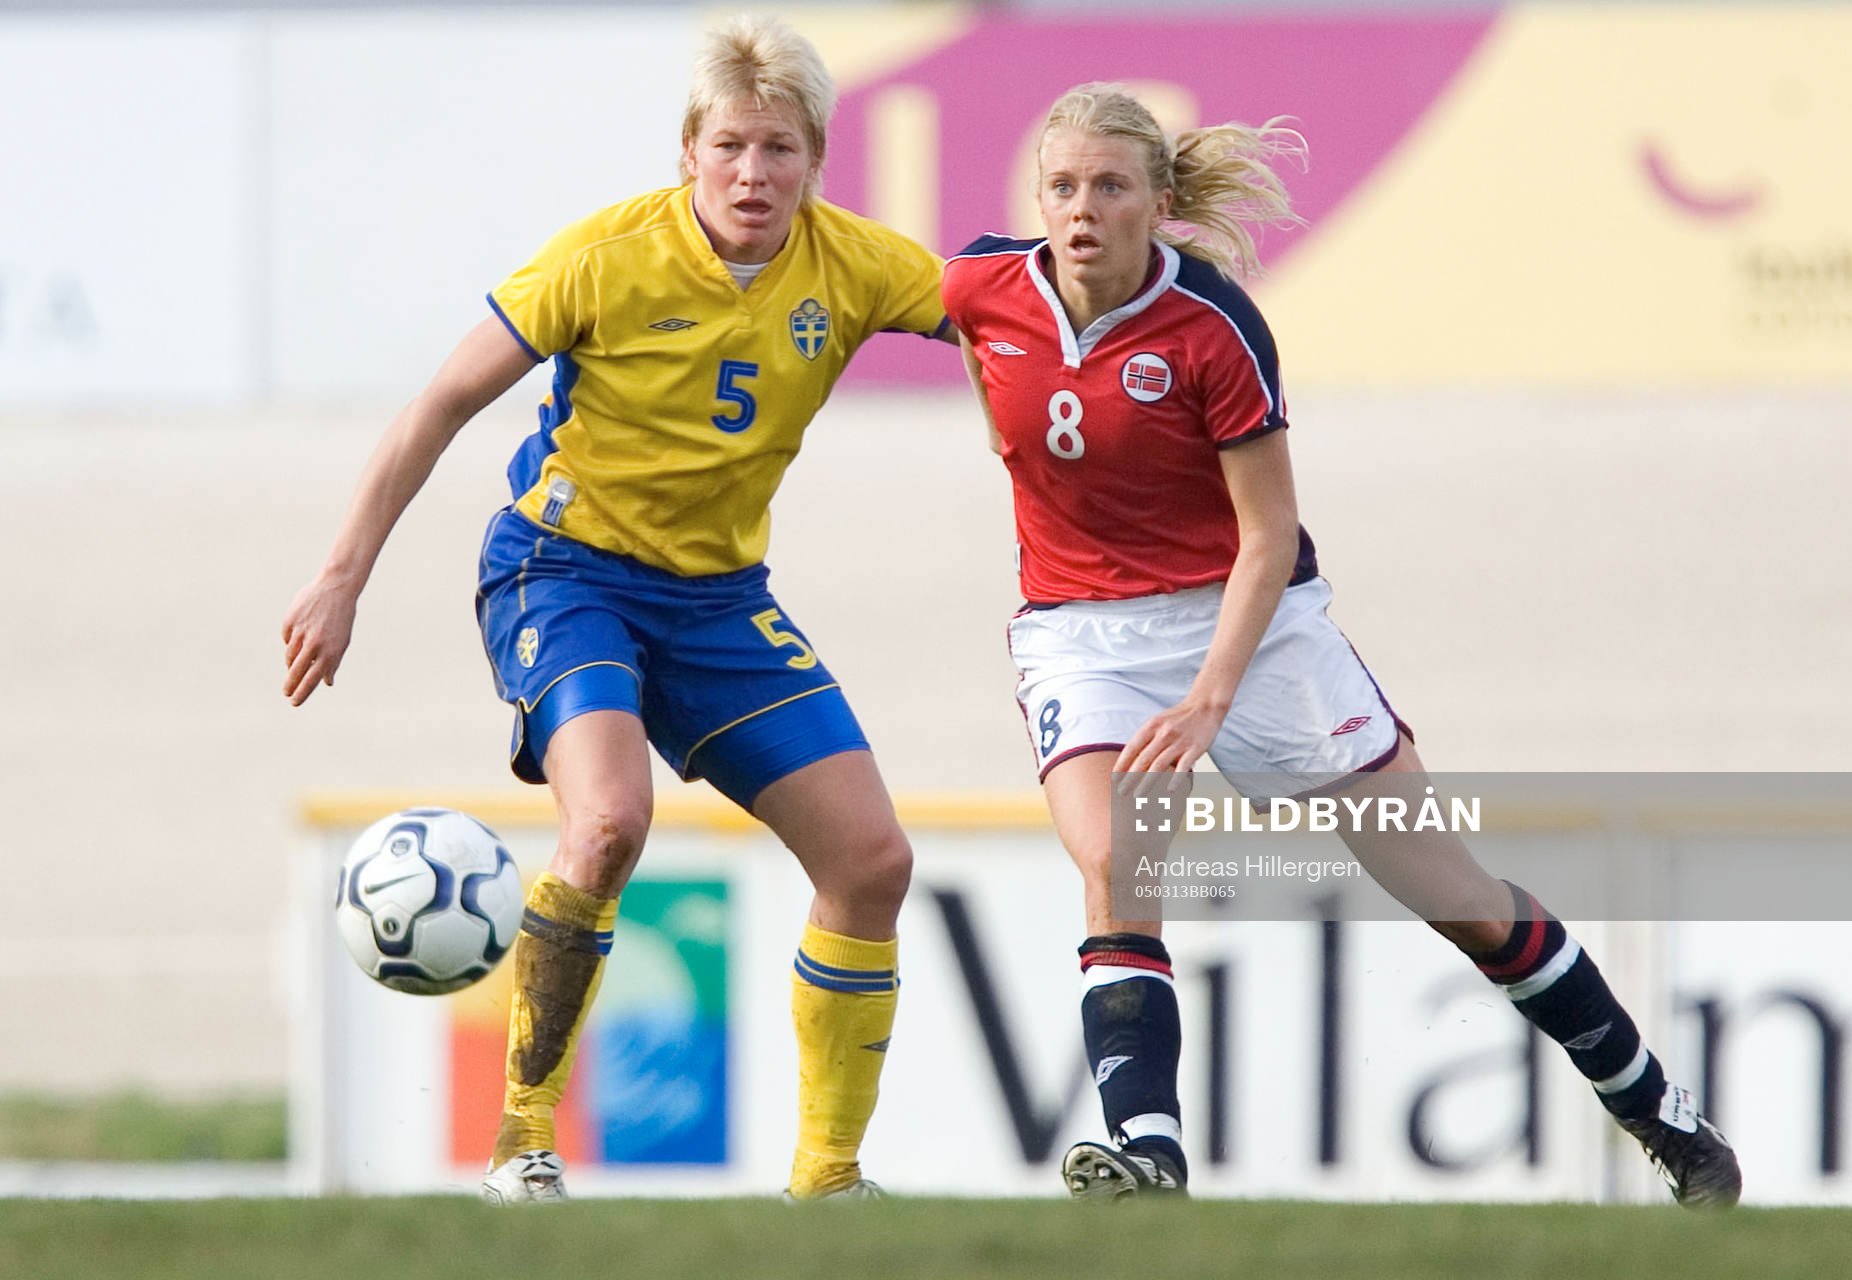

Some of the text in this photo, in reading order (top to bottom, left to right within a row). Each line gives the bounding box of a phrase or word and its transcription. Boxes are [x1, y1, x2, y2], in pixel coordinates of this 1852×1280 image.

[711, 360, 759, 433] 5
[1046, 390, 1085, 460] 8
[751, 608, 818, 669] 5
[1039, 699, 1064, 758] 8
